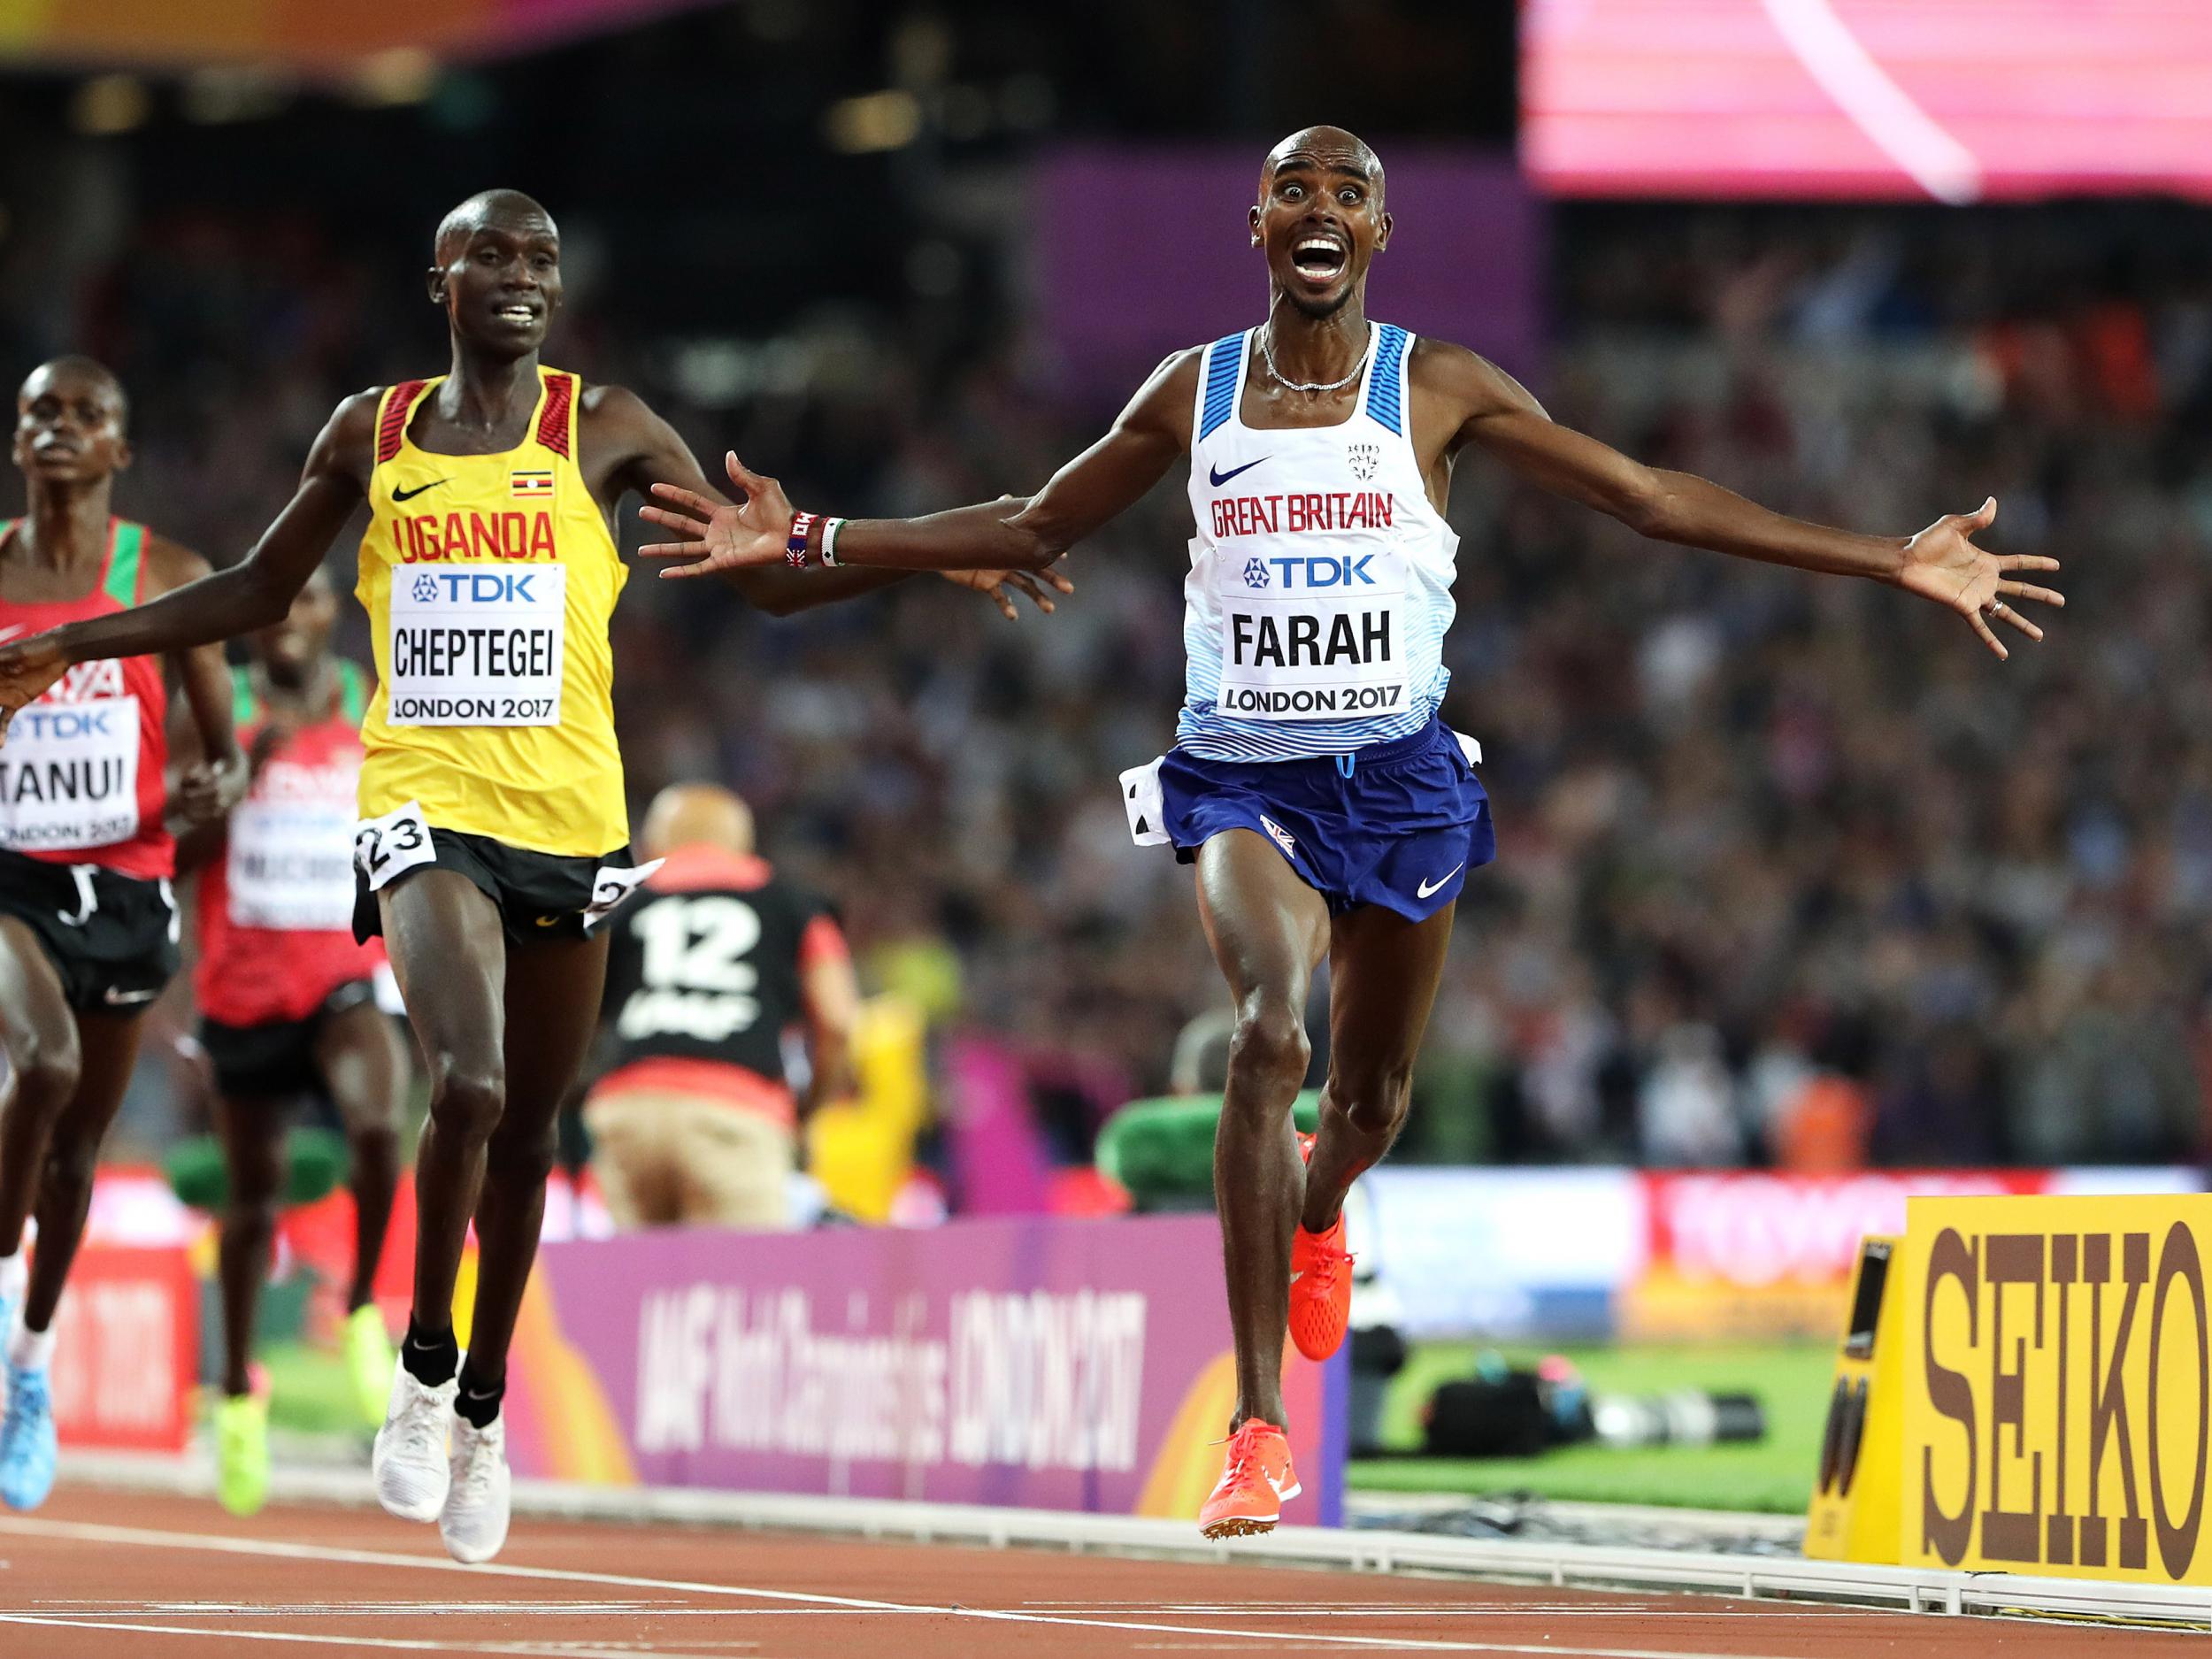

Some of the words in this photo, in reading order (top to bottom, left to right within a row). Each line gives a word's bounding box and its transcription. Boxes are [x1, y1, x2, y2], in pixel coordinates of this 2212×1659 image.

[392, 511, 557, 564] UGANDA
[1211, 495, 1284, 538] GREAT
[1287, 492, 1394, 533] BRITAIN
[439, 574, 536, 603] TDK
[1269, 554, 1377, 588] TDK
[395, 628, 553, 677] CHEPTEGEI
[1232, 611, 1391, 667] FARAH
[395, 698, 495, 718] LONDON
[502, 698, 554, 718] 2017
[1225, 688, 1337, 712] LONDON
[1341, 685, 1402, 710] 2017
[25, 710, 112, 739] TDK
[356, 818, 425, 876] 23
[629, 895, 762, 989] 12
[1923, 1220, 2209, 1580] SEIKO
